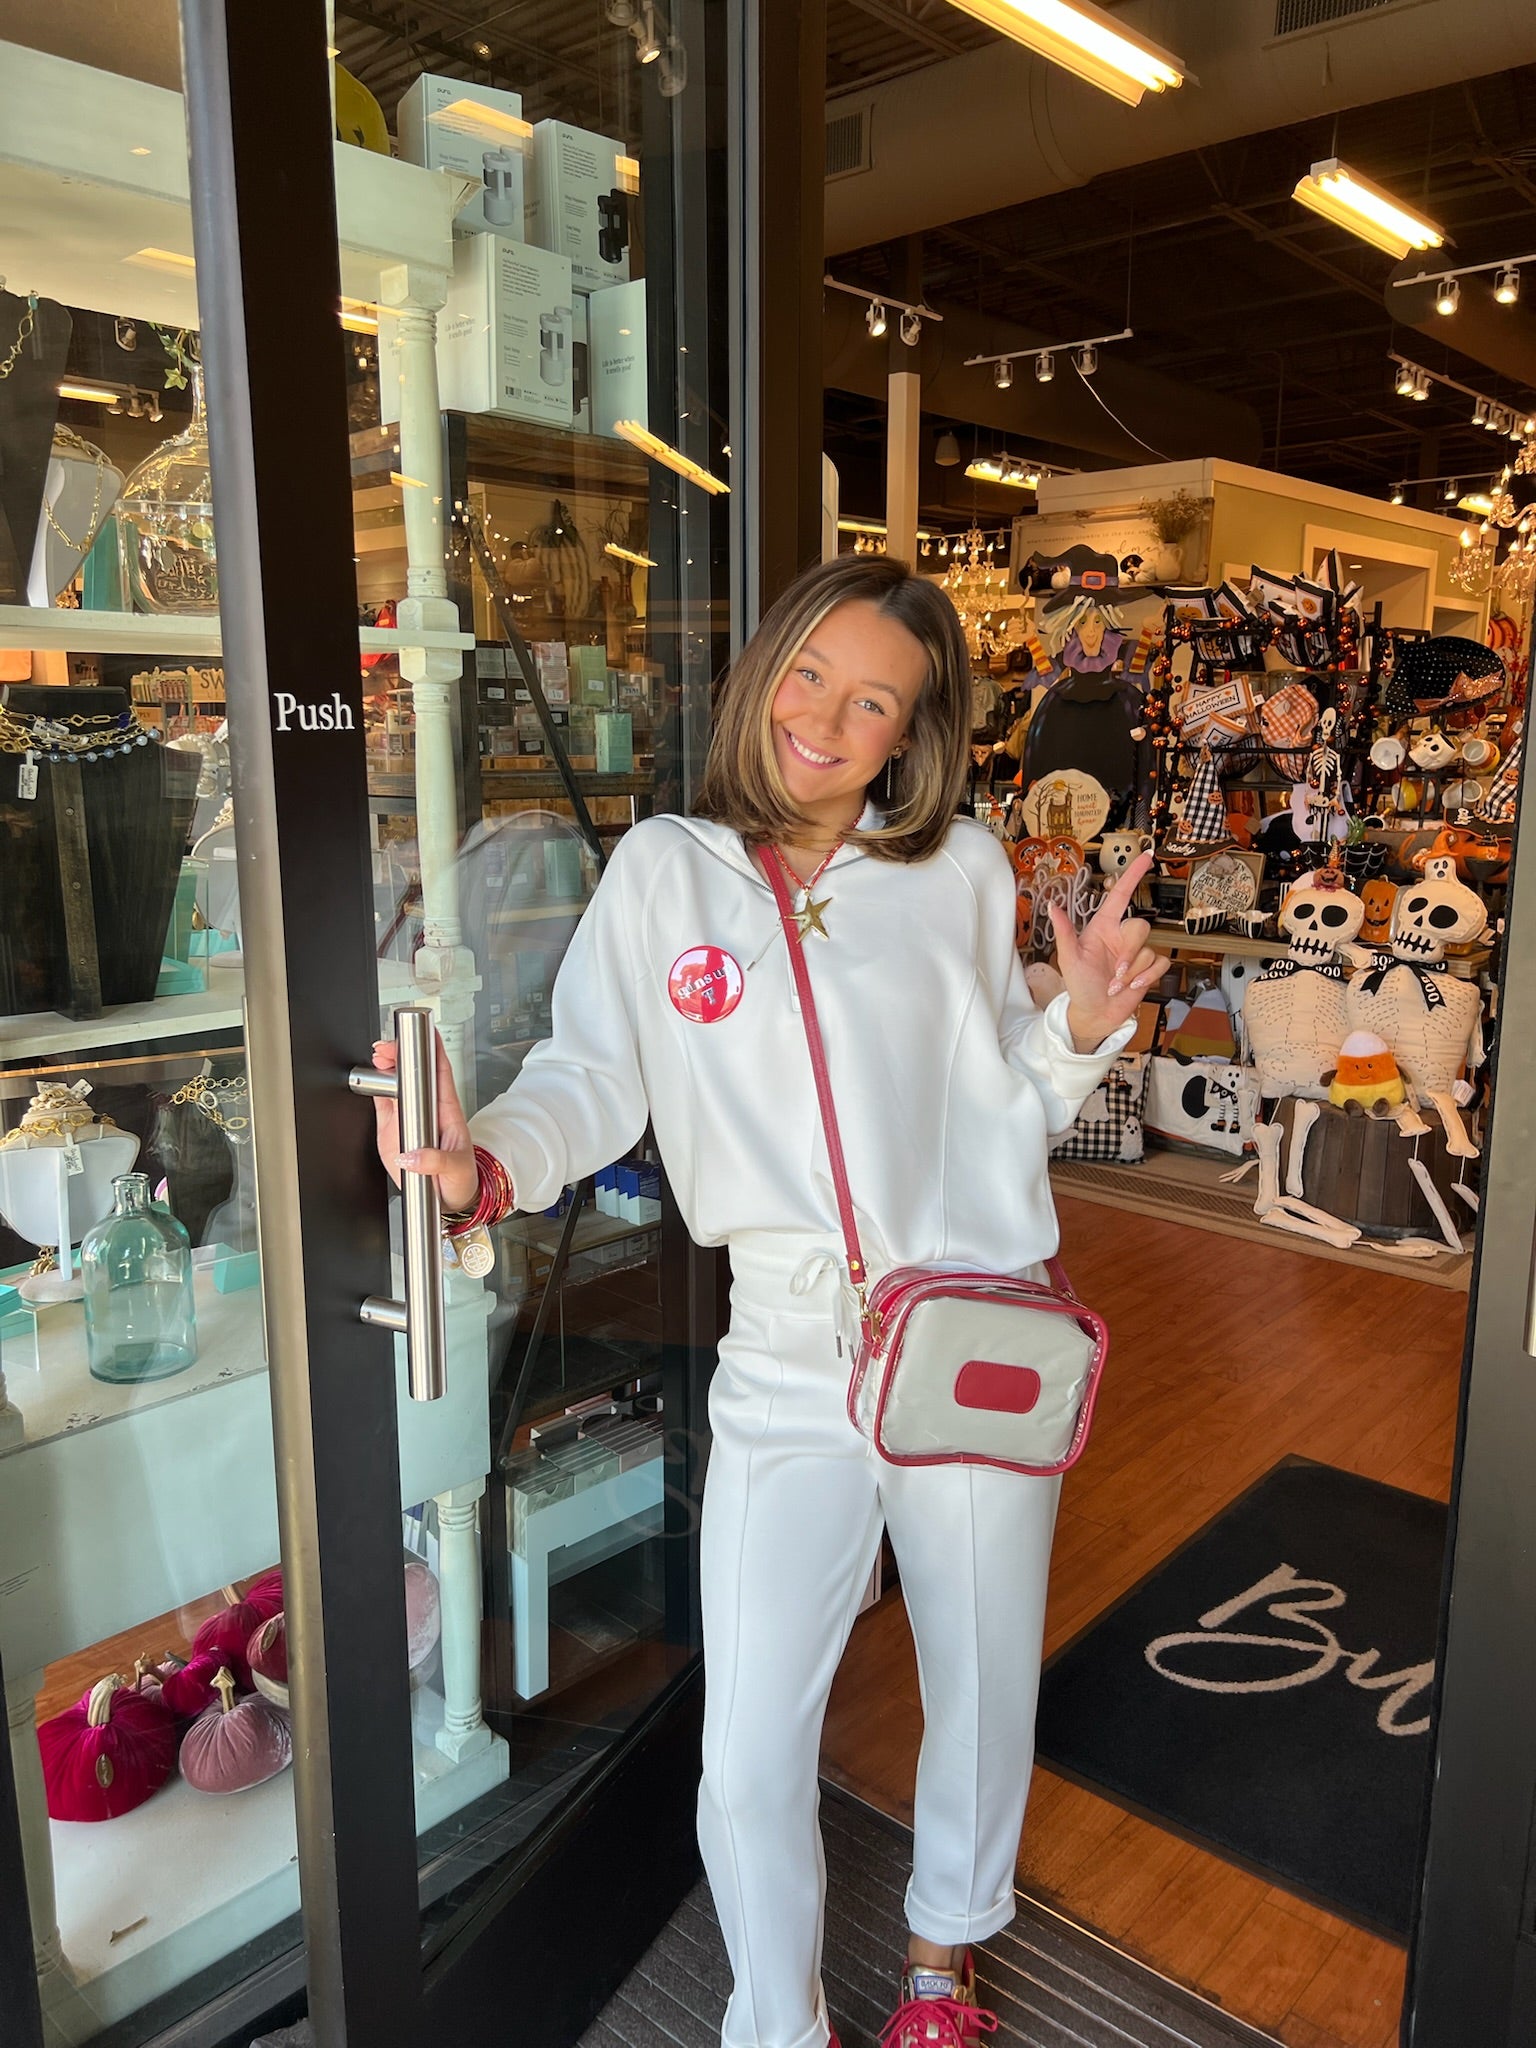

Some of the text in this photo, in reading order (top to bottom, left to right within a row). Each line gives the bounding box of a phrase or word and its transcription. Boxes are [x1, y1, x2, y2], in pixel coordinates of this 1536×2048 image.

[273, 692, 355, 732] Push
[1186, 695, 1236, 720] HALLOWEEN
[1195, 693, 1222, 708] HAPPY
[1420, 976, 1440, 1003] BOO
